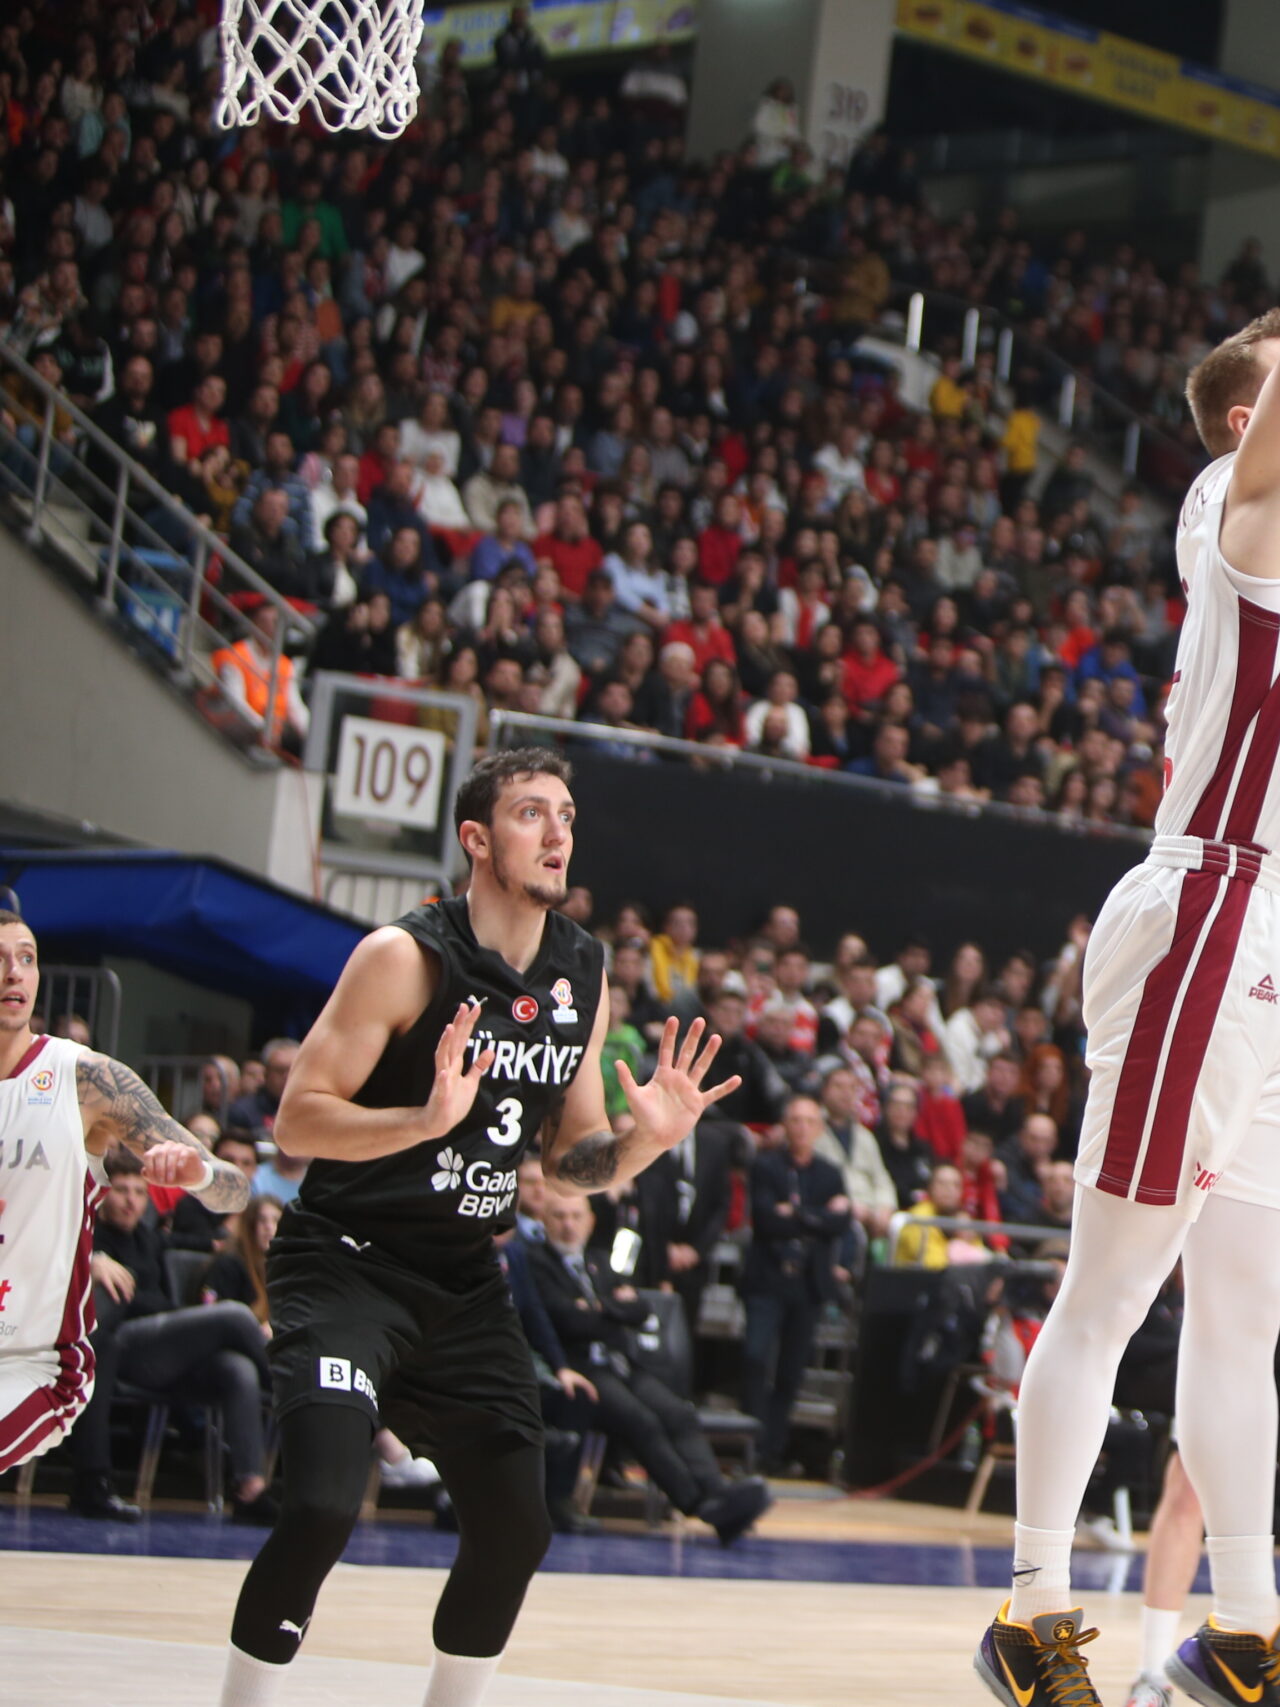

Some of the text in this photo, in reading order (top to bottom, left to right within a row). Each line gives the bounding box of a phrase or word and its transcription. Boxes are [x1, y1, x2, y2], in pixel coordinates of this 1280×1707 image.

[353, 734, 433, 808] 109
[1249, 986, 1280, 1005] PEAK
[487, 1097, 523, 1146] 3
[466, 1160, 517, 1192] Gara
